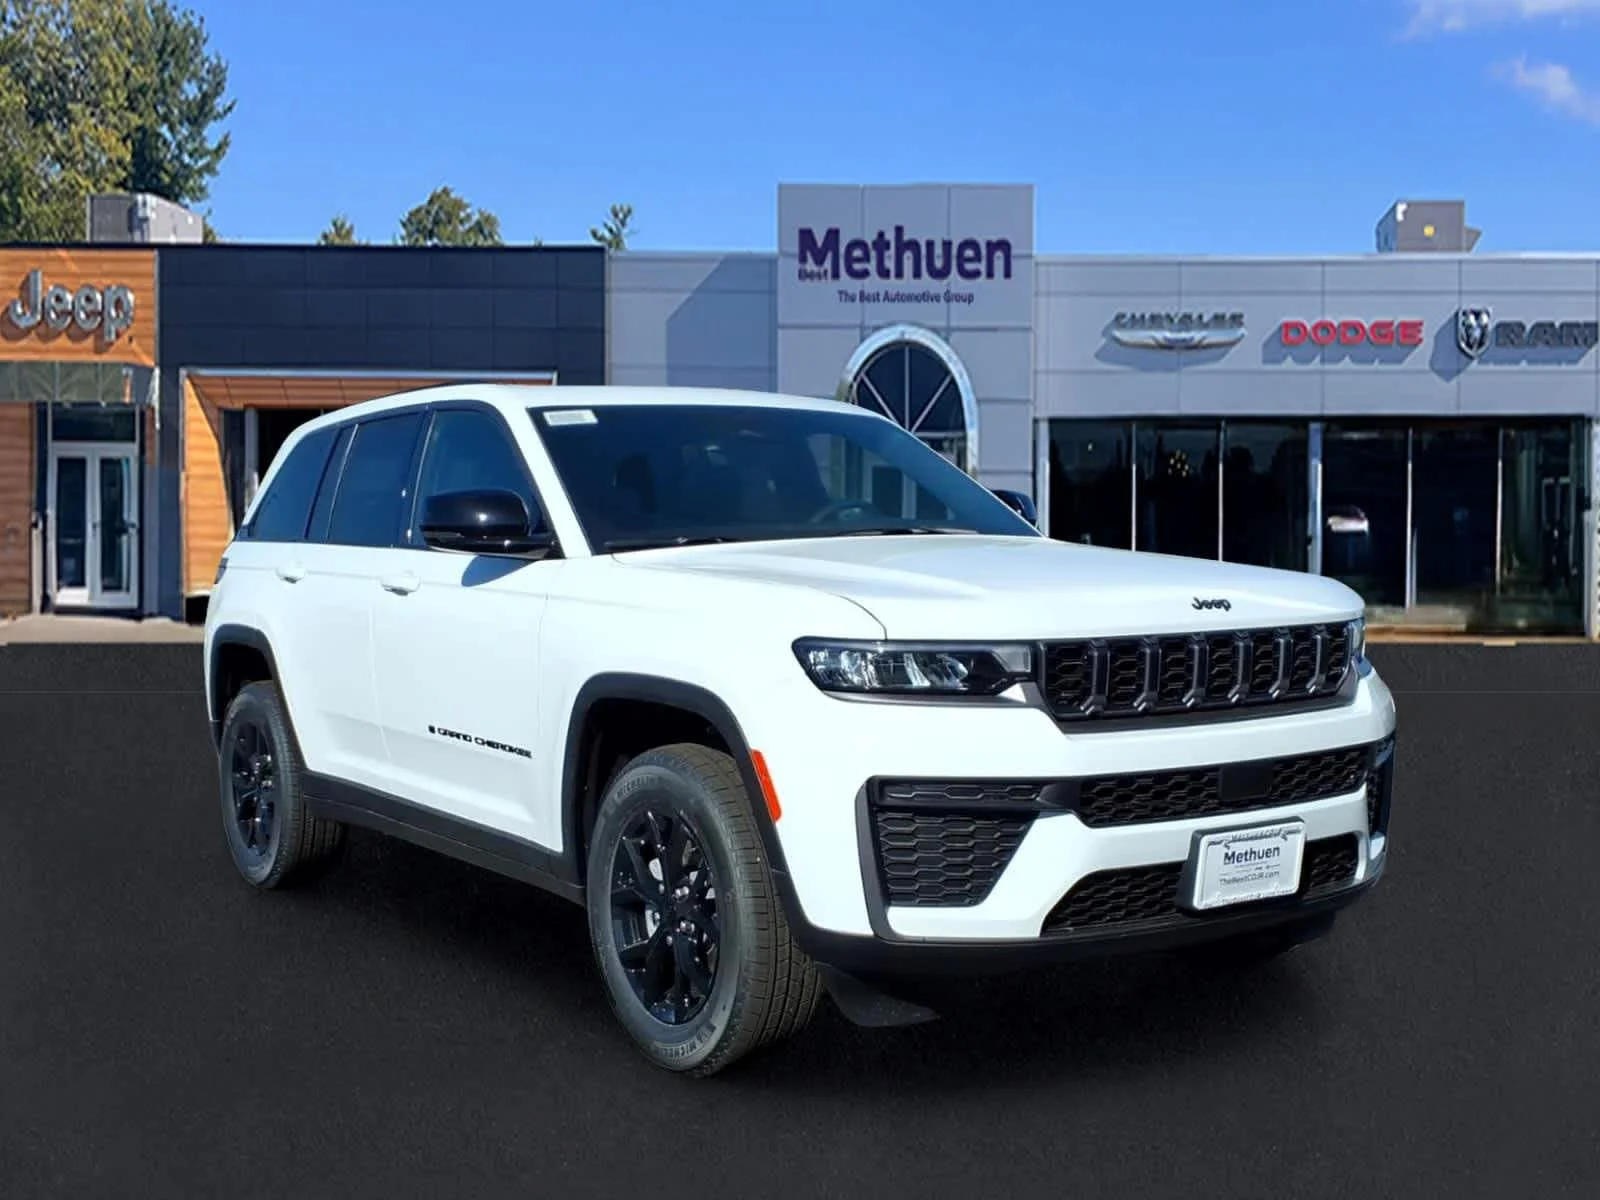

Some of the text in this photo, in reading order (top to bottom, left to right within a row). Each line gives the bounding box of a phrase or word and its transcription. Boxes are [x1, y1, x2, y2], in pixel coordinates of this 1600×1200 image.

[798, 225, 1012, 281] Methuen
[8, 269, 135, 342] Jeep
[837, 288, 974, 305] The Best Automotive Group
[1114, 311, 1245, 329] CHRYSLER
[1281, 319, 1424, 346] DODGE
[1495, 321, 1600, 347] RAM
[1191, 596, 1232, 612] Jeep
[437, 727, 472, 743] GRAND
[1223, 846, 1281, 865] Methuen
